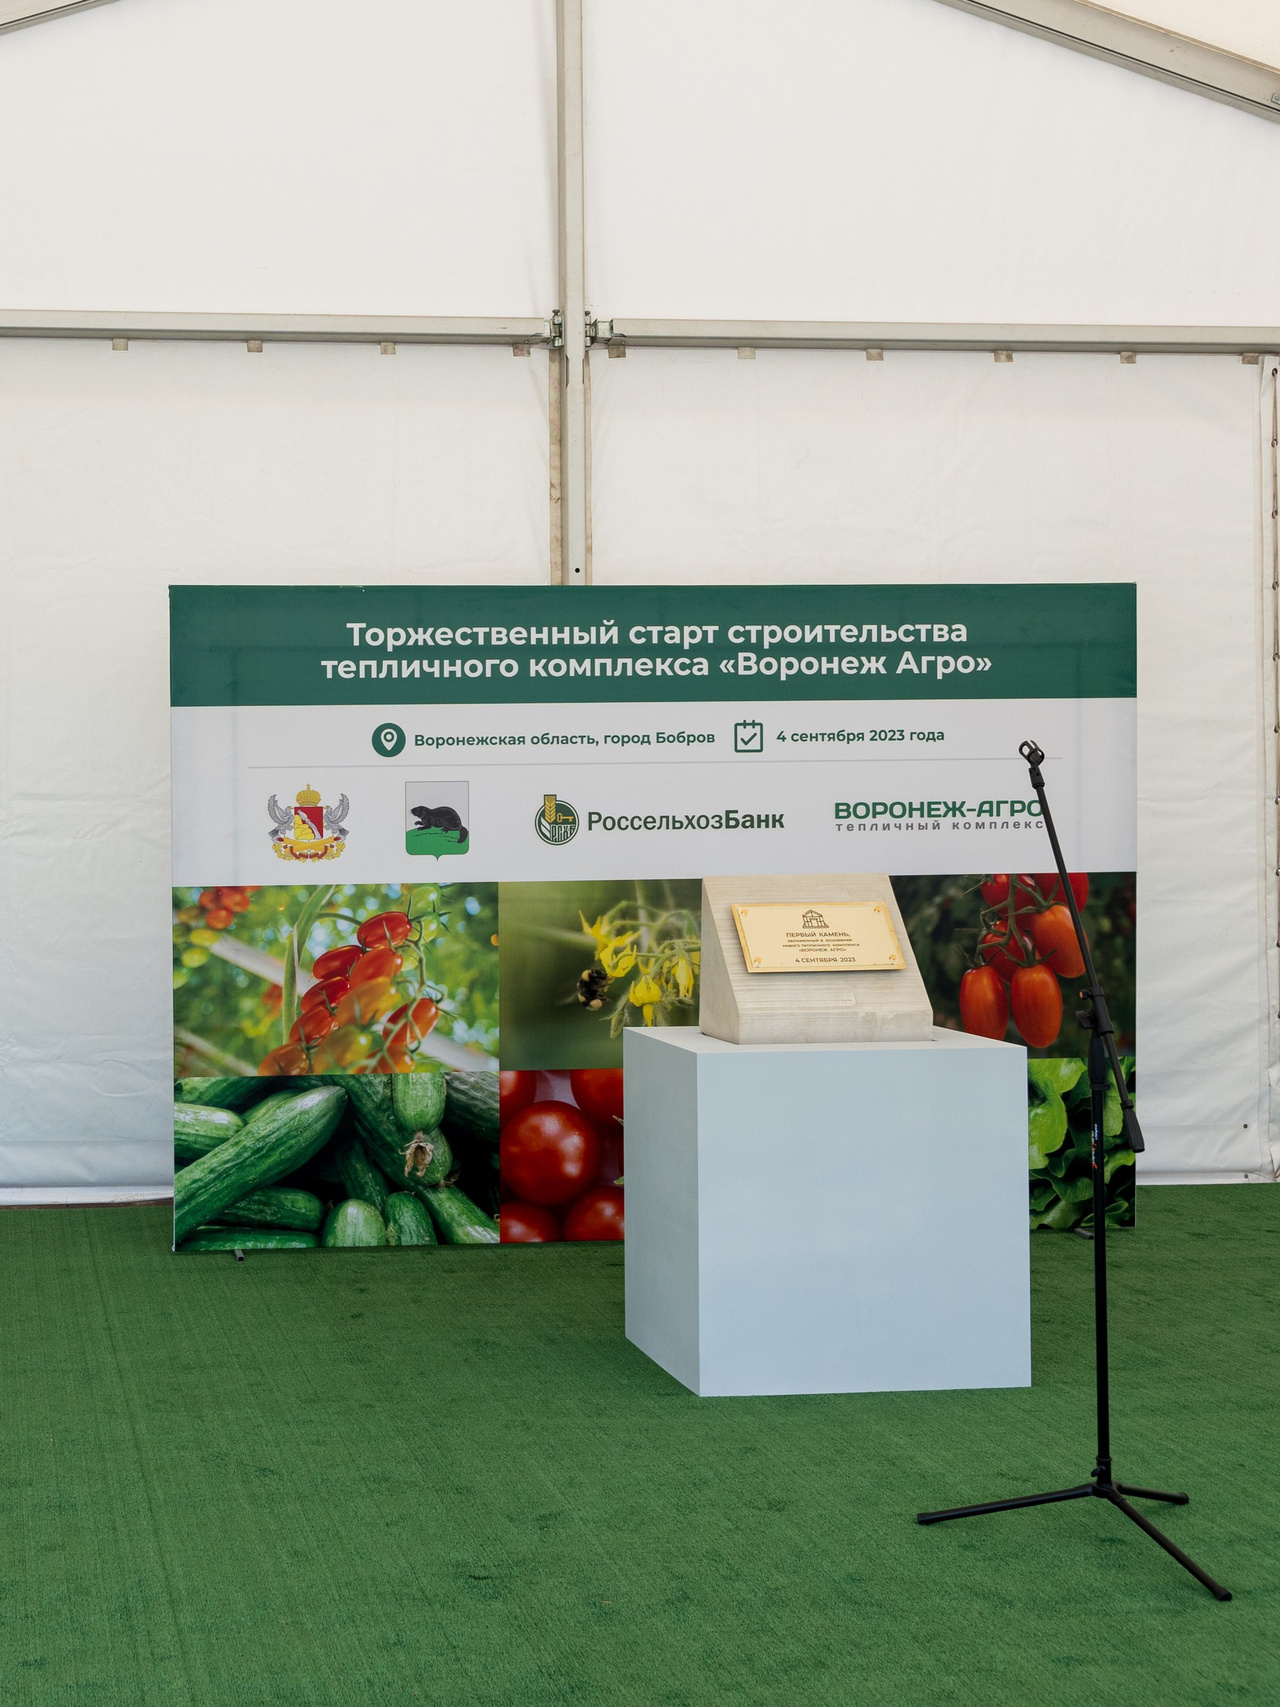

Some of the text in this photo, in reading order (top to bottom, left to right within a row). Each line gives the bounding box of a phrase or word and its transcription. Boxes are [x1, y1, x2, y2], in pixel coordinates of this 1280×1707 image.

[347, 620, 967, 652] Торжественный старт строительства
[321, 651, 991, 680] тепличного комплекса «Воронеж Агро»
[415, 731, 715, 749] Воронежская область, город Бобров
[777, 730, 944, 744] 4 сентября 2023 года
[834, 800, 1044, 819] ВОРОНЕЖ-АГРО
[588, 810, 784, 831] РоссельхозБанк
[836, 820, 1043, 831] тепличный комплекс
